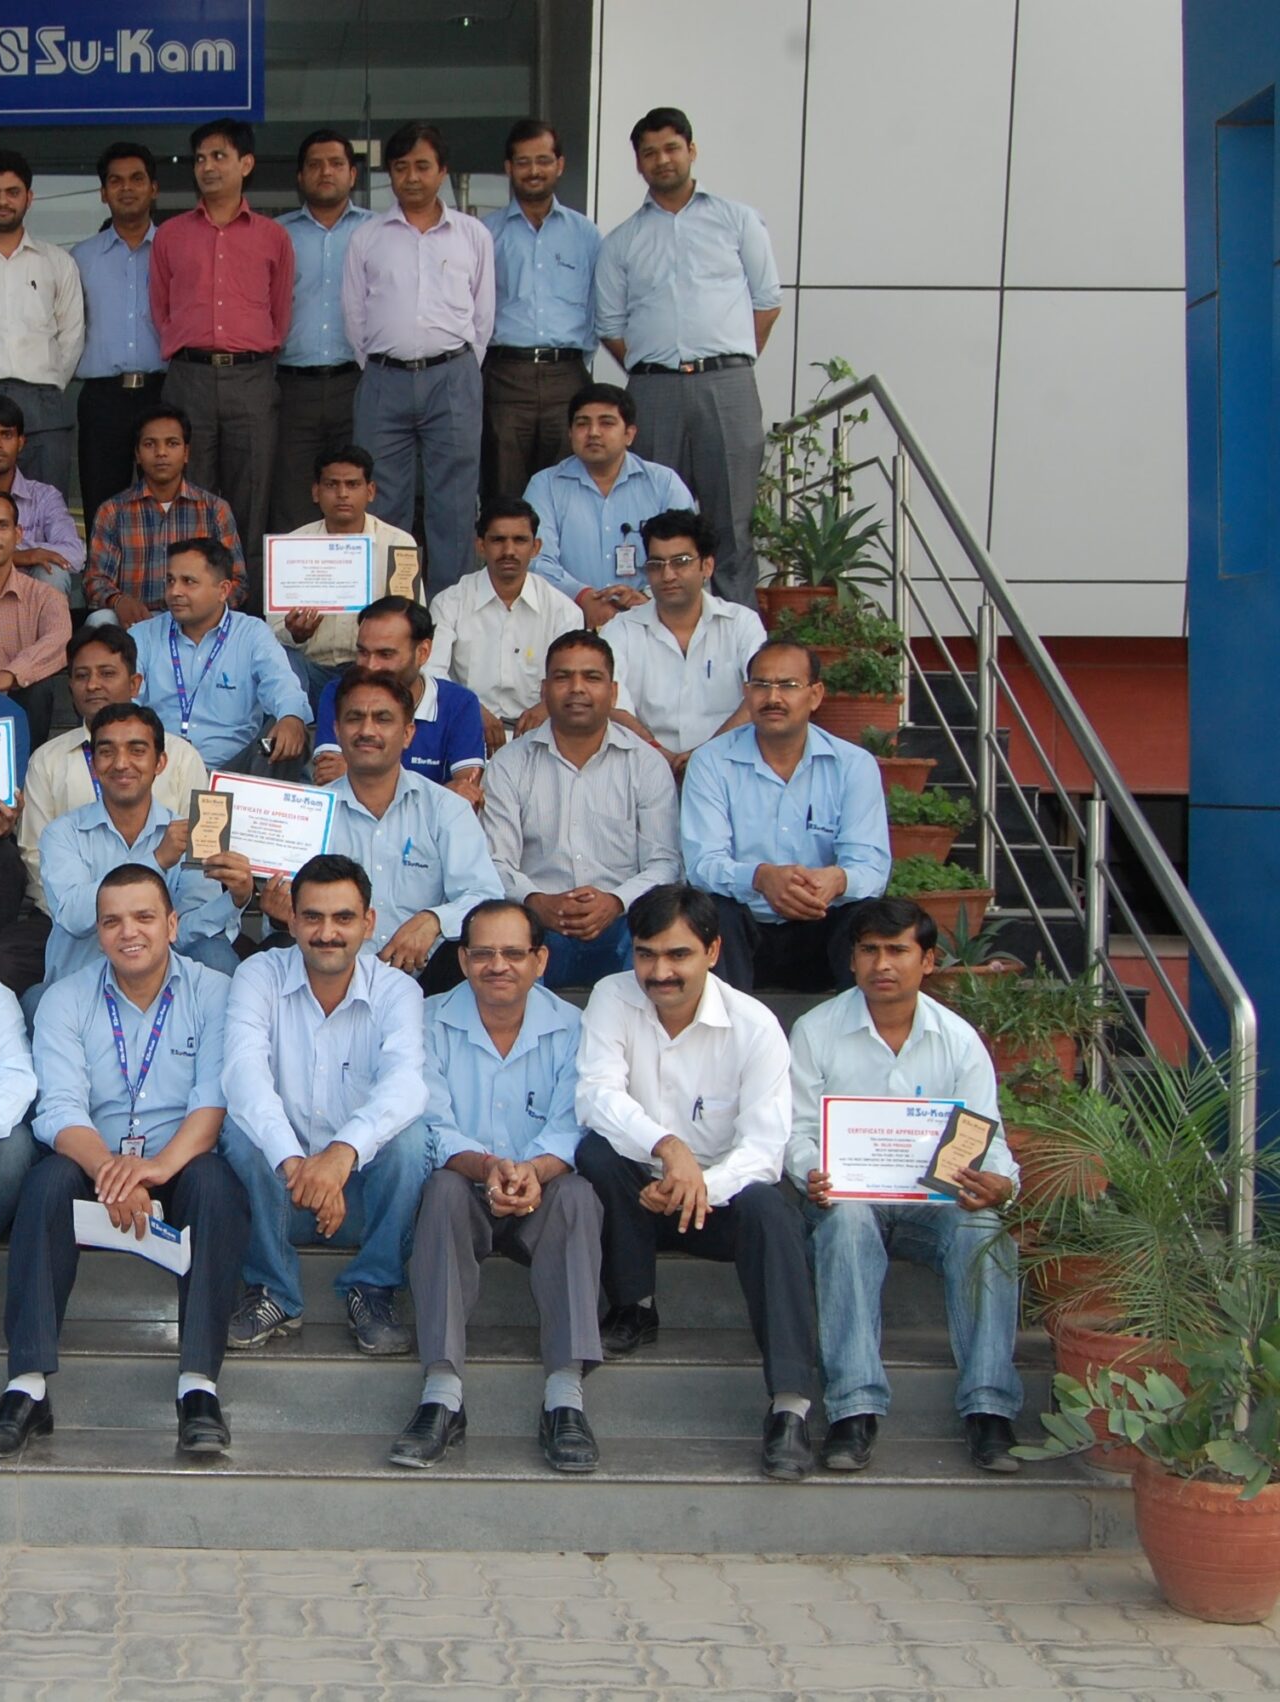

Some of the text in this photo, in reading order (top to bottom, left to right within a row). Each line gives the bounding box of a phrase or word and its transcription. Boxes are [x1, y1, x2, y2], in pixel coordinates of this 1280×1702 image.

[35, 26, 236, 75] Su-Kam
[233, 804, 262, 815] ERTIFICATE
[895, 1129, 939, 1137] APPRECIATION
